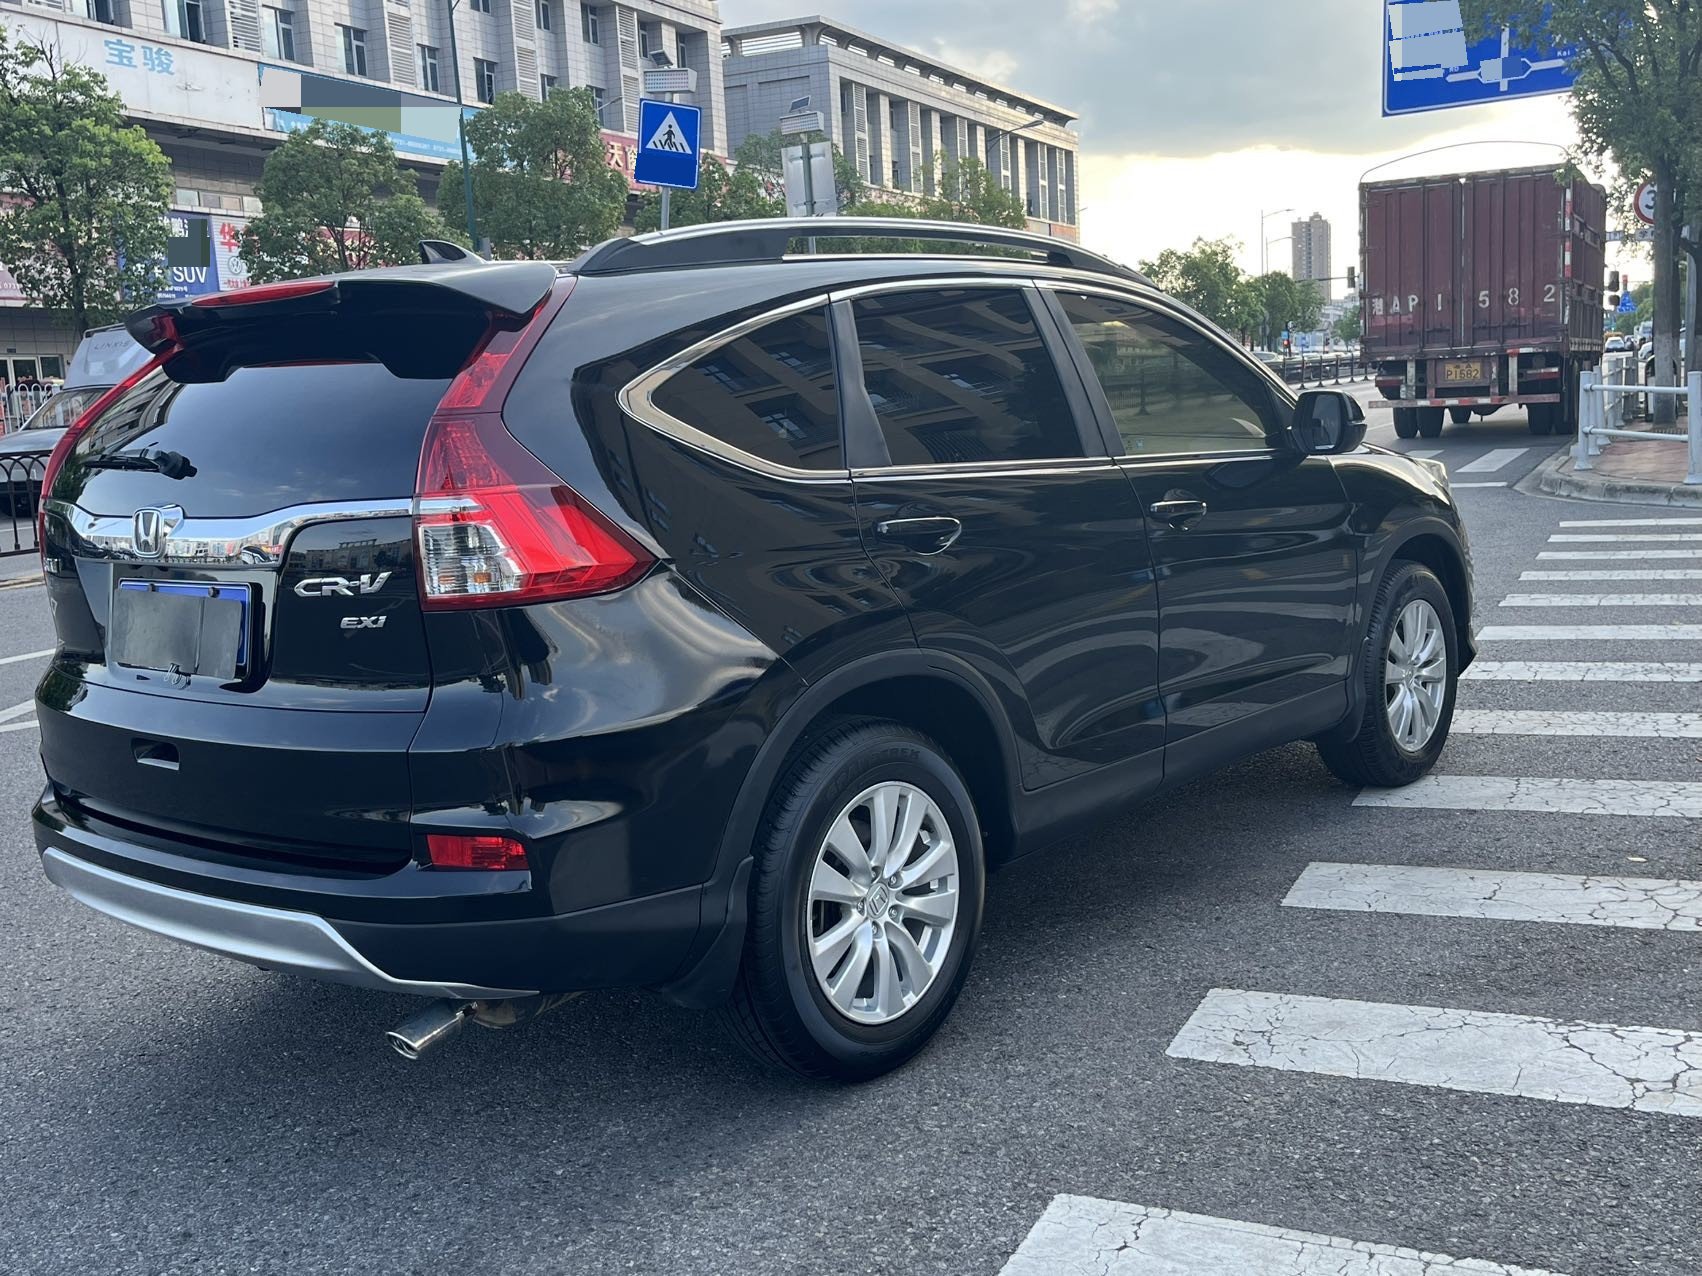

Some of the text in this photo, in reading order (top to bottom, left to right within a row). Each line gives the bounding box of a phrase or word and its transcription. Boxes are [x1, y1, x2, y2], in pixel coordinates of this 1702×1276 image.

[104, 39, 174, 75] 宝骏
[173, 266, 207, 283] SUV
[1446, 369, 1480, 379] P1582
[294, 571, 393, 597] CR-V
